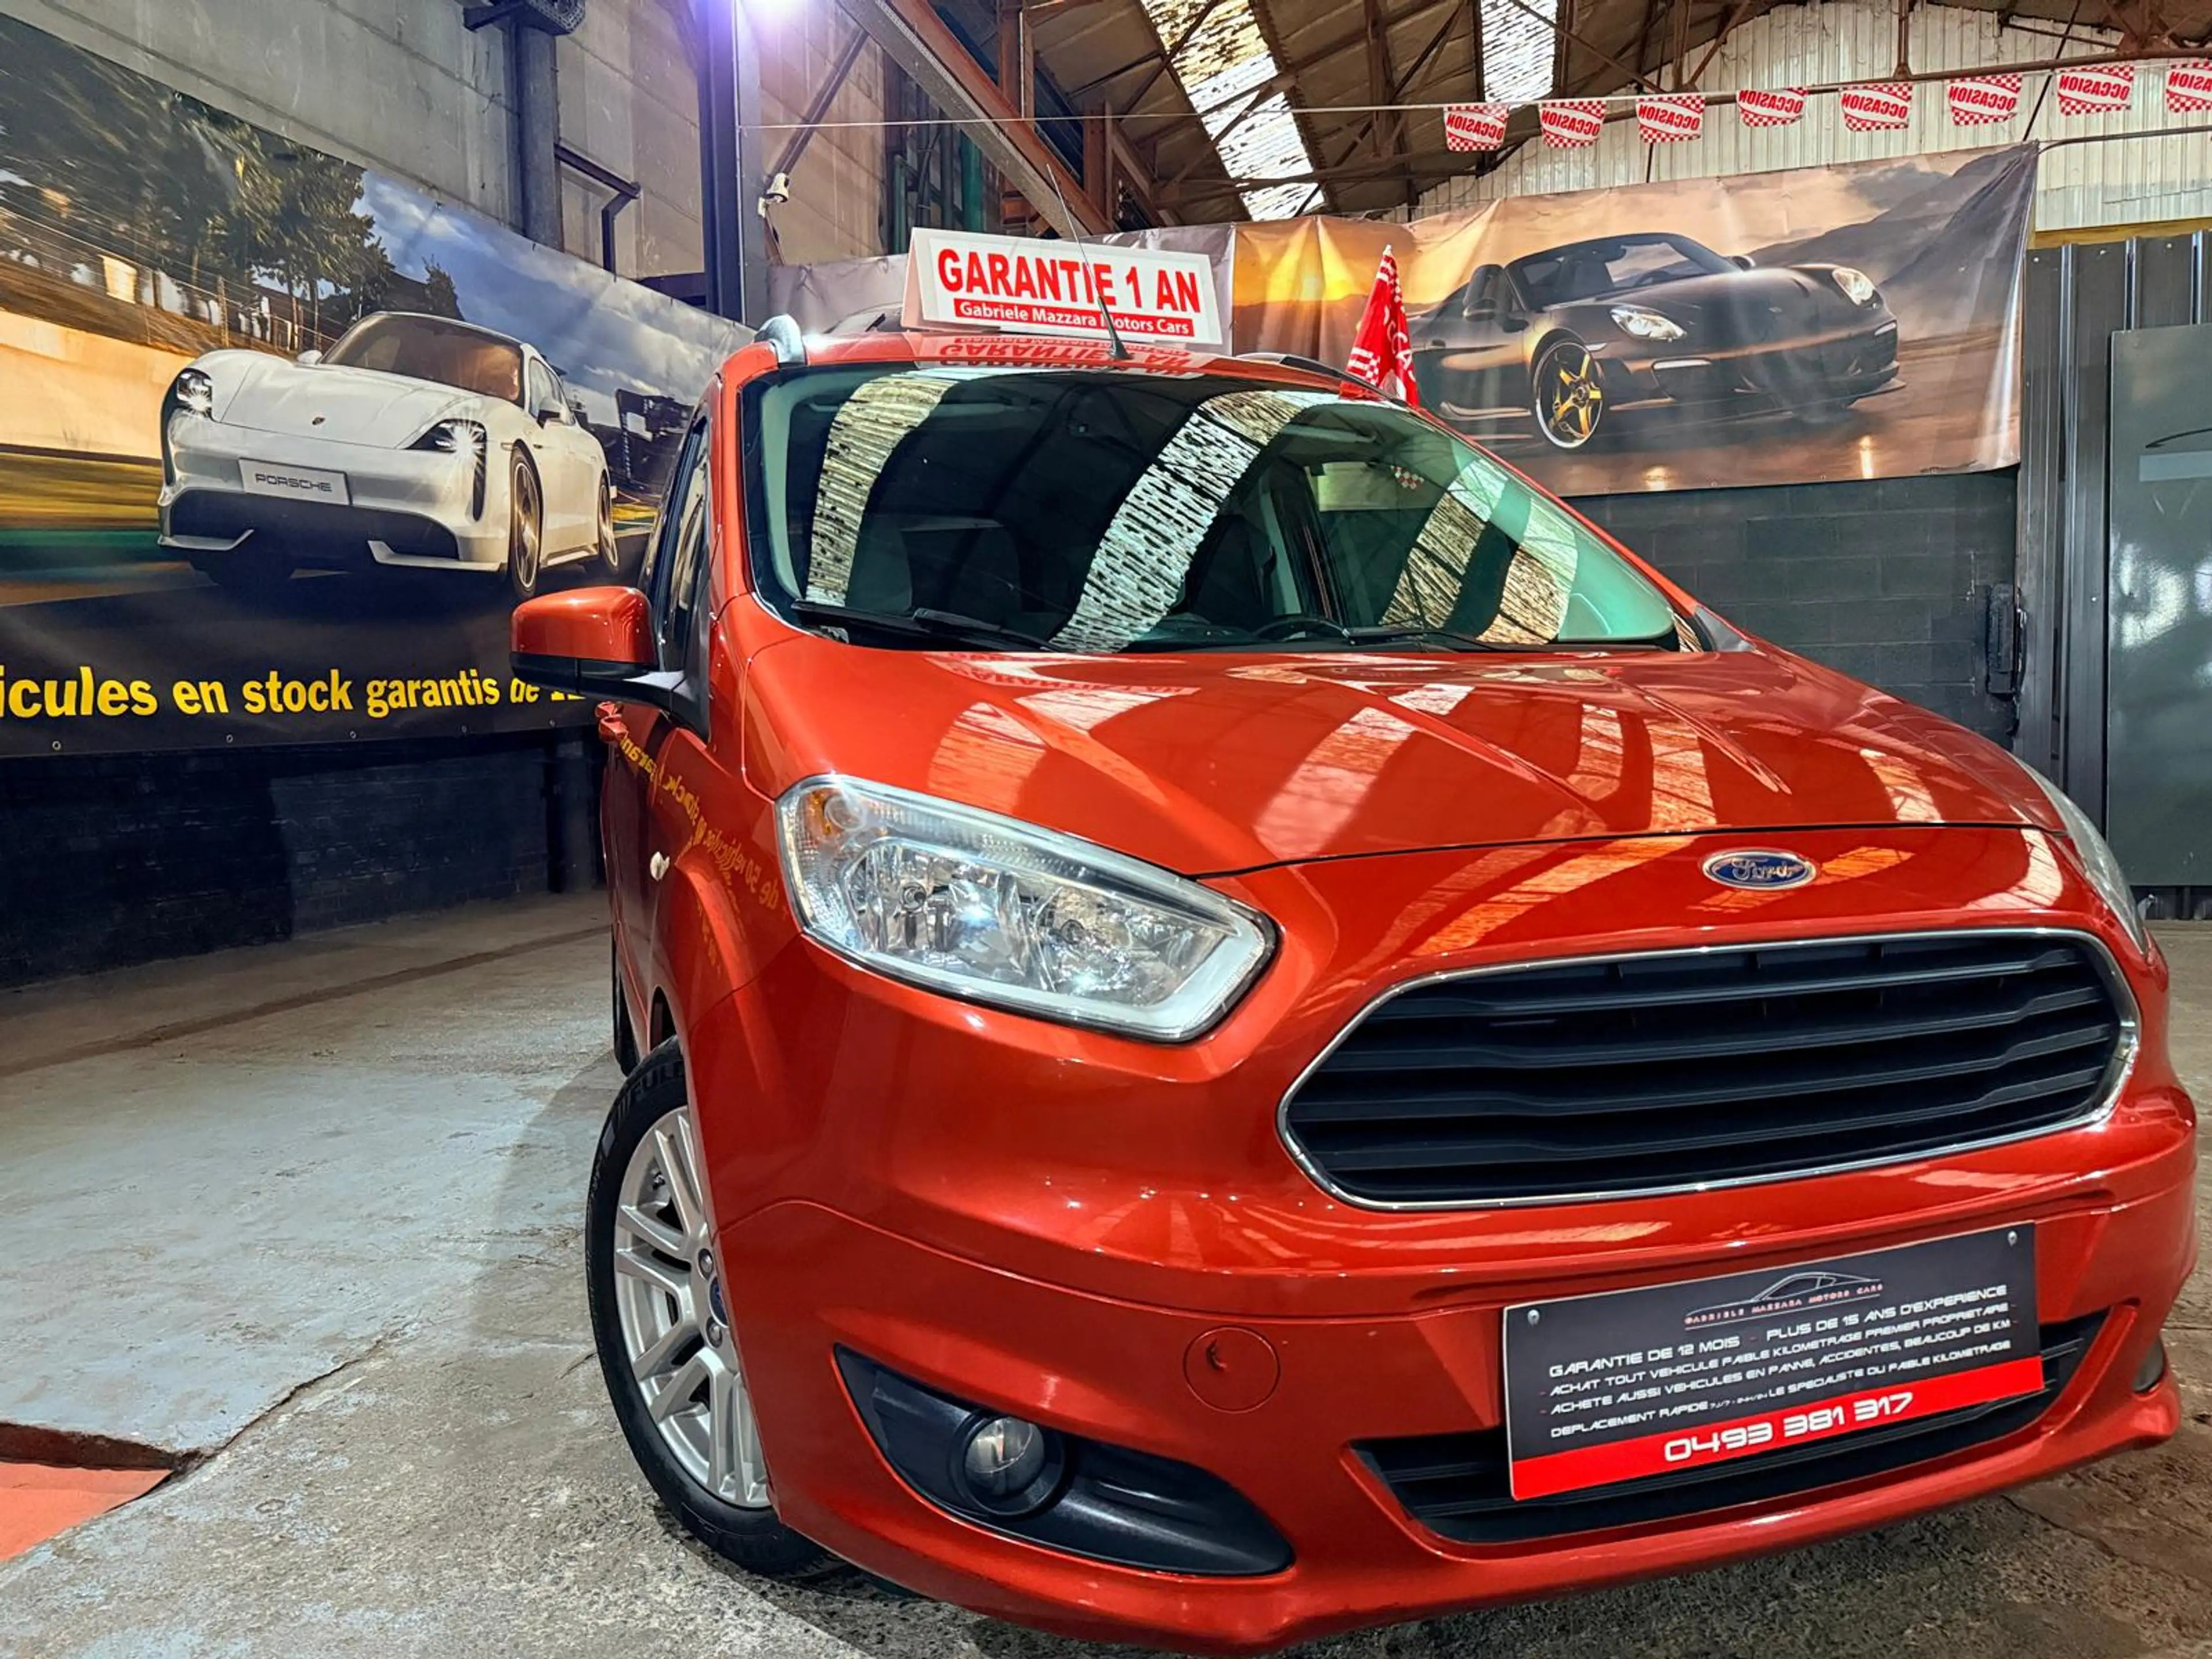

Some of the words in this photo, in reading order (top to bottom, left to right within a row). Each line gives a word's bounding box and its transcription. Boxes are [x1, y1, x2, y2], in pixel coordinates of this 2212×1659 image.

[937, 248, 1118, 307] GARANTIE
[1125, 266, 1142, 309] 1
[1156, 269, 1202, 313] AN
[960, 301, 1028, 321] Gabriele
[1032, 306, 1097, 327] Mazzara
[1157, 319, 1189, 334] Cars
[255, 473, 332, 492] PORSCHE
[173, 681, 229, 715] en
[243, 669, 354, 714] stock
[367, 669, 500, 718] garantis
[1549, 1351, 1643, 1378] GARANTIE
[1648, 1347, 1673, 1362] DE
[1677, 1343, 1695, 1357] 12
[1699, 1335, 1740, 1354] MOIS
[1767, 1324, 1812, 1341] PLUS
[1816, 1317, 1838, 1332] DE
[1843, 1314, 1859, 1327] 15
[1863, 1306, 1896, 1323] ANS
[1901, 1284, 2008, 1316] D'EXPERIENCE
[1550, 1378, 1601, 1397] ACHAT
[1605, 1371, 1646, 1387] TOUT
[1649, 1359, 1719, 1380] VEHICULE
[1722, 1351, 1770, 1367] FAIBLE
[1772, 1331, 1862, 1358] KILOMETRAGE
[1865, 1319, 1921, 1338] PREMIER
[1550, 1395, 1613, 1415] ACHETE
[1616, 1388, 1662, 1403] AUSSI
[1664, 1372, 1743, 1395] VEHICULES
[1745, 1365, 1766, 1380] EN
[1768, 1358, 1816, 1376] PANNE,
[1819, 1341, 1902, 1365] ACCIDENTES,
[1904, 1327, 1971, 1348] BEAUCOUP
[1974, 1323, 1991, 1335] DE
[1992, 1319, 2011, 1330] KM
[1551, 1410, 1656, 1438] DEPLACEMENT
[1659, 1401, 1709, 1418] RAPIDE
[1768, 1386, 1785, 1397] LE
[1867, 1364, 1885, 1376] DU
[1888, 1356, 1931, 1372] FAIBLE
[1933, 1340, 2012, 1364] KILOMETRAGE
[1664, 1422, 1773, 1462] 0493
[1783, 1406, 1846, 1438] 381
[1853, 1391, 1914, 1422] 317
